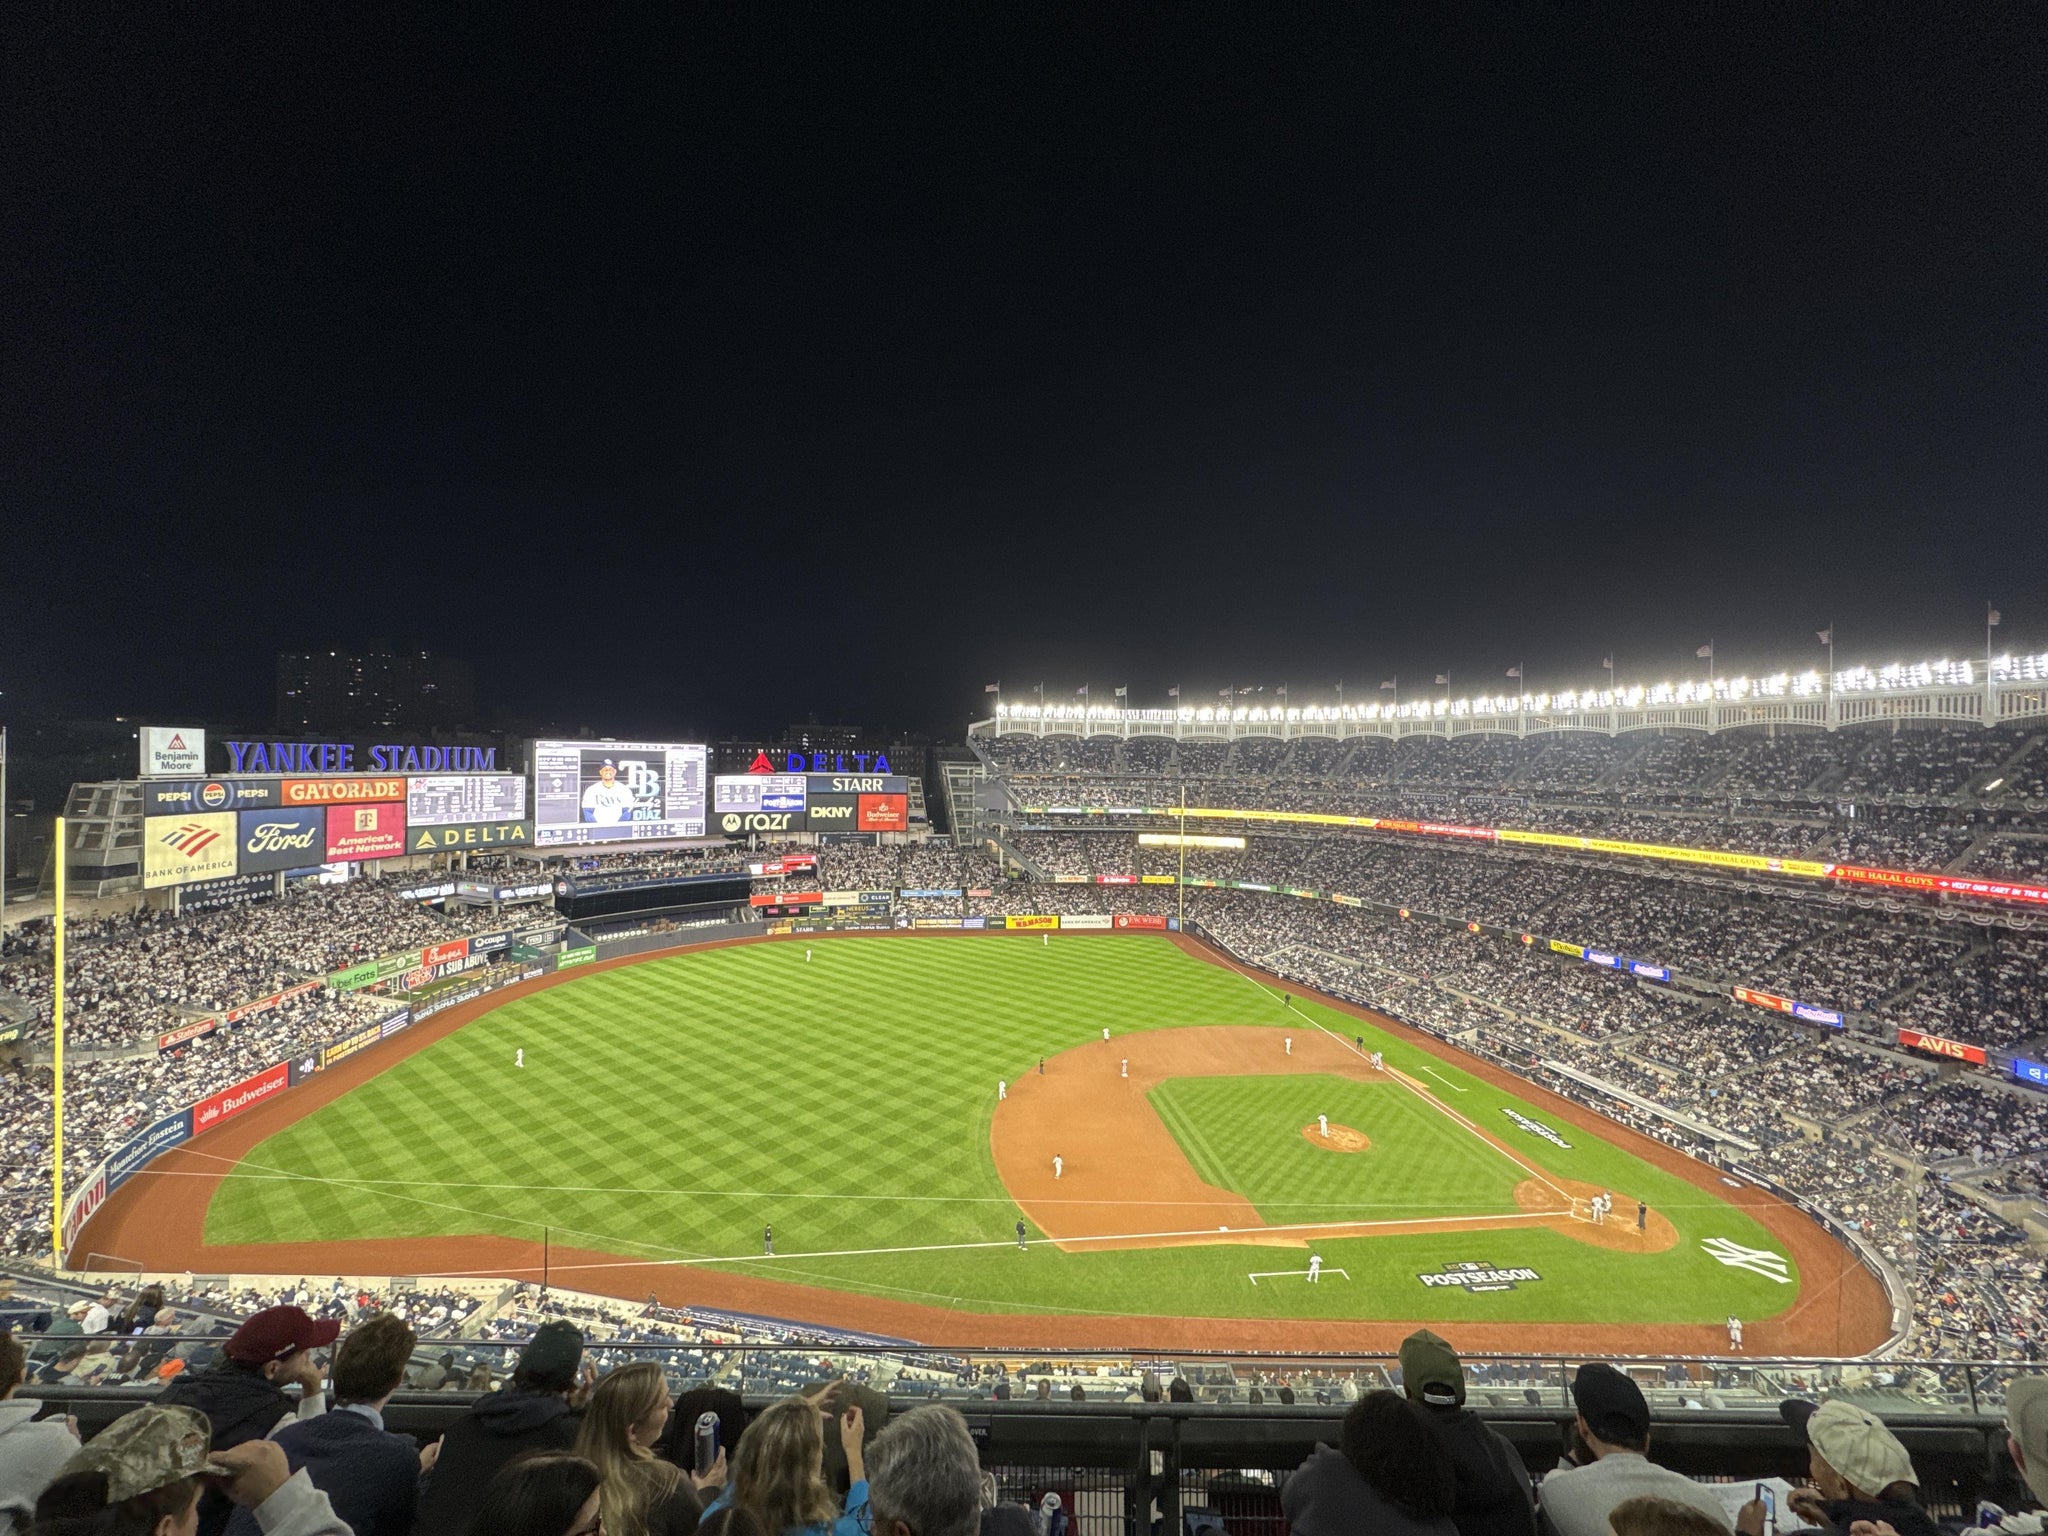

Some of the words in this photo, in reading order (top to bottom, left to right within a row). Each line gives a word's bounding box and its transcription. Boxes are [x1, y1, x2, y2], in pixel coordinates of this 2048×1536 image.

[155, 752, 199, 762] Benjamin
[161, 761, 192, 770] Moore
[225, 742, 354, 773] YANKEE
[370, 745, 496, 772] STADIUM
[787, 753, 891, 773] DELTA
[290, 782, 399, 800] GATORADE
[832, 778, 883, 791] STARR
[157, 792, 191, 802] PEPSI
[237, 789, 268, 798] PEPSI
[810, 806, 853, 818] DKNY
[745, 813, 791, 830] razr
[247, 823, 316, 853] Ford
[338, 834, 393, 846] America's
[445, 826, 525, 845] DELTA
[328, 846, 354, 856] Best
[355, 842, 401, 853] Network
[1714, 854, 1738, 863] HALAL
[146, 869, 173, 878] BANK
[176, 867, 188, 875] OF
[191, 861, 233, 872] AMERICA
[1846, 869, 1866, 878] THE
[1868, 872, 1902, 882] HALAL
[1990, 886, 2011, 894] CART
[2024, 890, 2040, 898] THE
[484, 935, 506, 944] coupa
[439, 964, 445, 977] A
[446, 959, 463, 975] SUB
[464, 953, 489, 969] ABOVE
[331, 978, 352, 989] Uber
[354, 970, 375, 984] Eats
[1918, 1036, 1964, 1057] AVIS
[222, 1076, 285, 1114] Budweiser
[110, 1142, 148, 1177] Montefiore
[149, 1120, 184, 1146] Einstein
[1420, 1268, 1540, 1286] POSTSEASON
